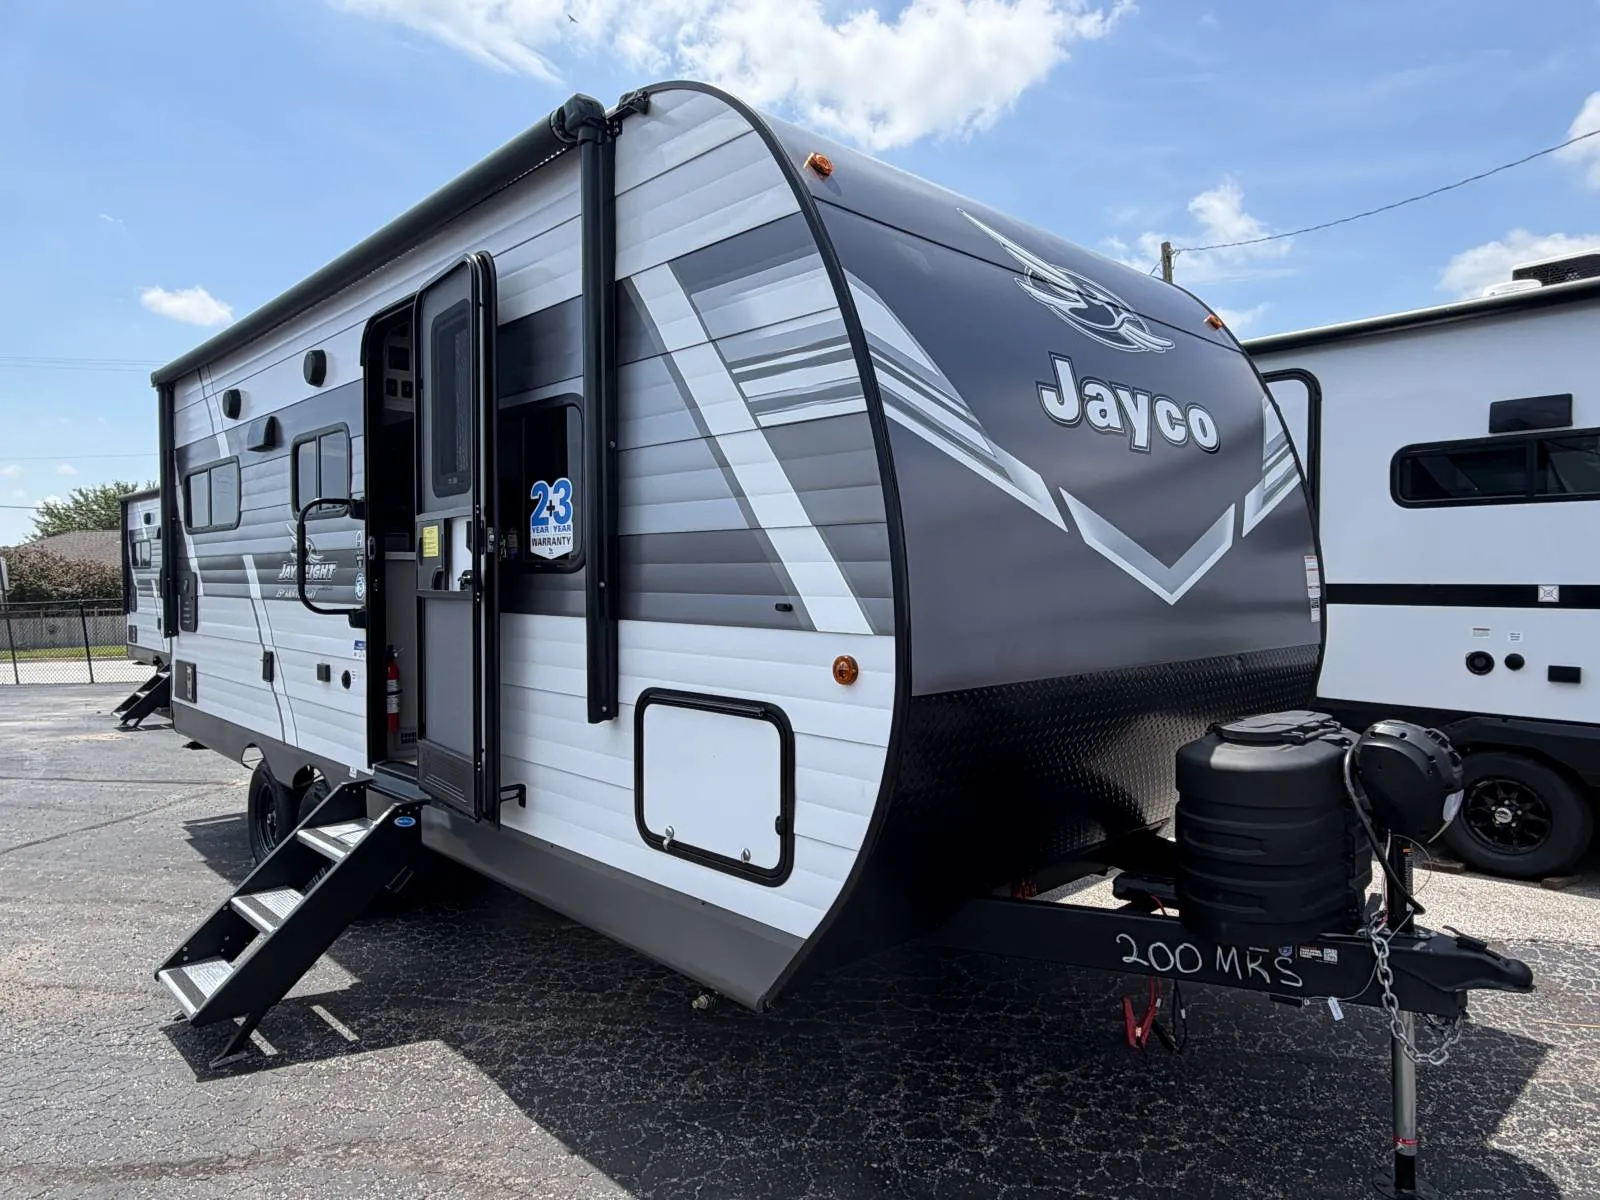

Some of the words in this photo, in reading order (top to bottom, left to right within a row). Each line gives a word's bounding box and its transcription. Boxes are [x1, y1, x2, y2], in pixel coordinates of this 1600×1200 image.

[1036, 352, 1220, 453] Jayco
[553, 524, 571, 532] YEAR
[532, 536, 572, 546] WARRANTY
[278, 563, 297, 579] JAY
[1116, 933, 1202, 973] 200
